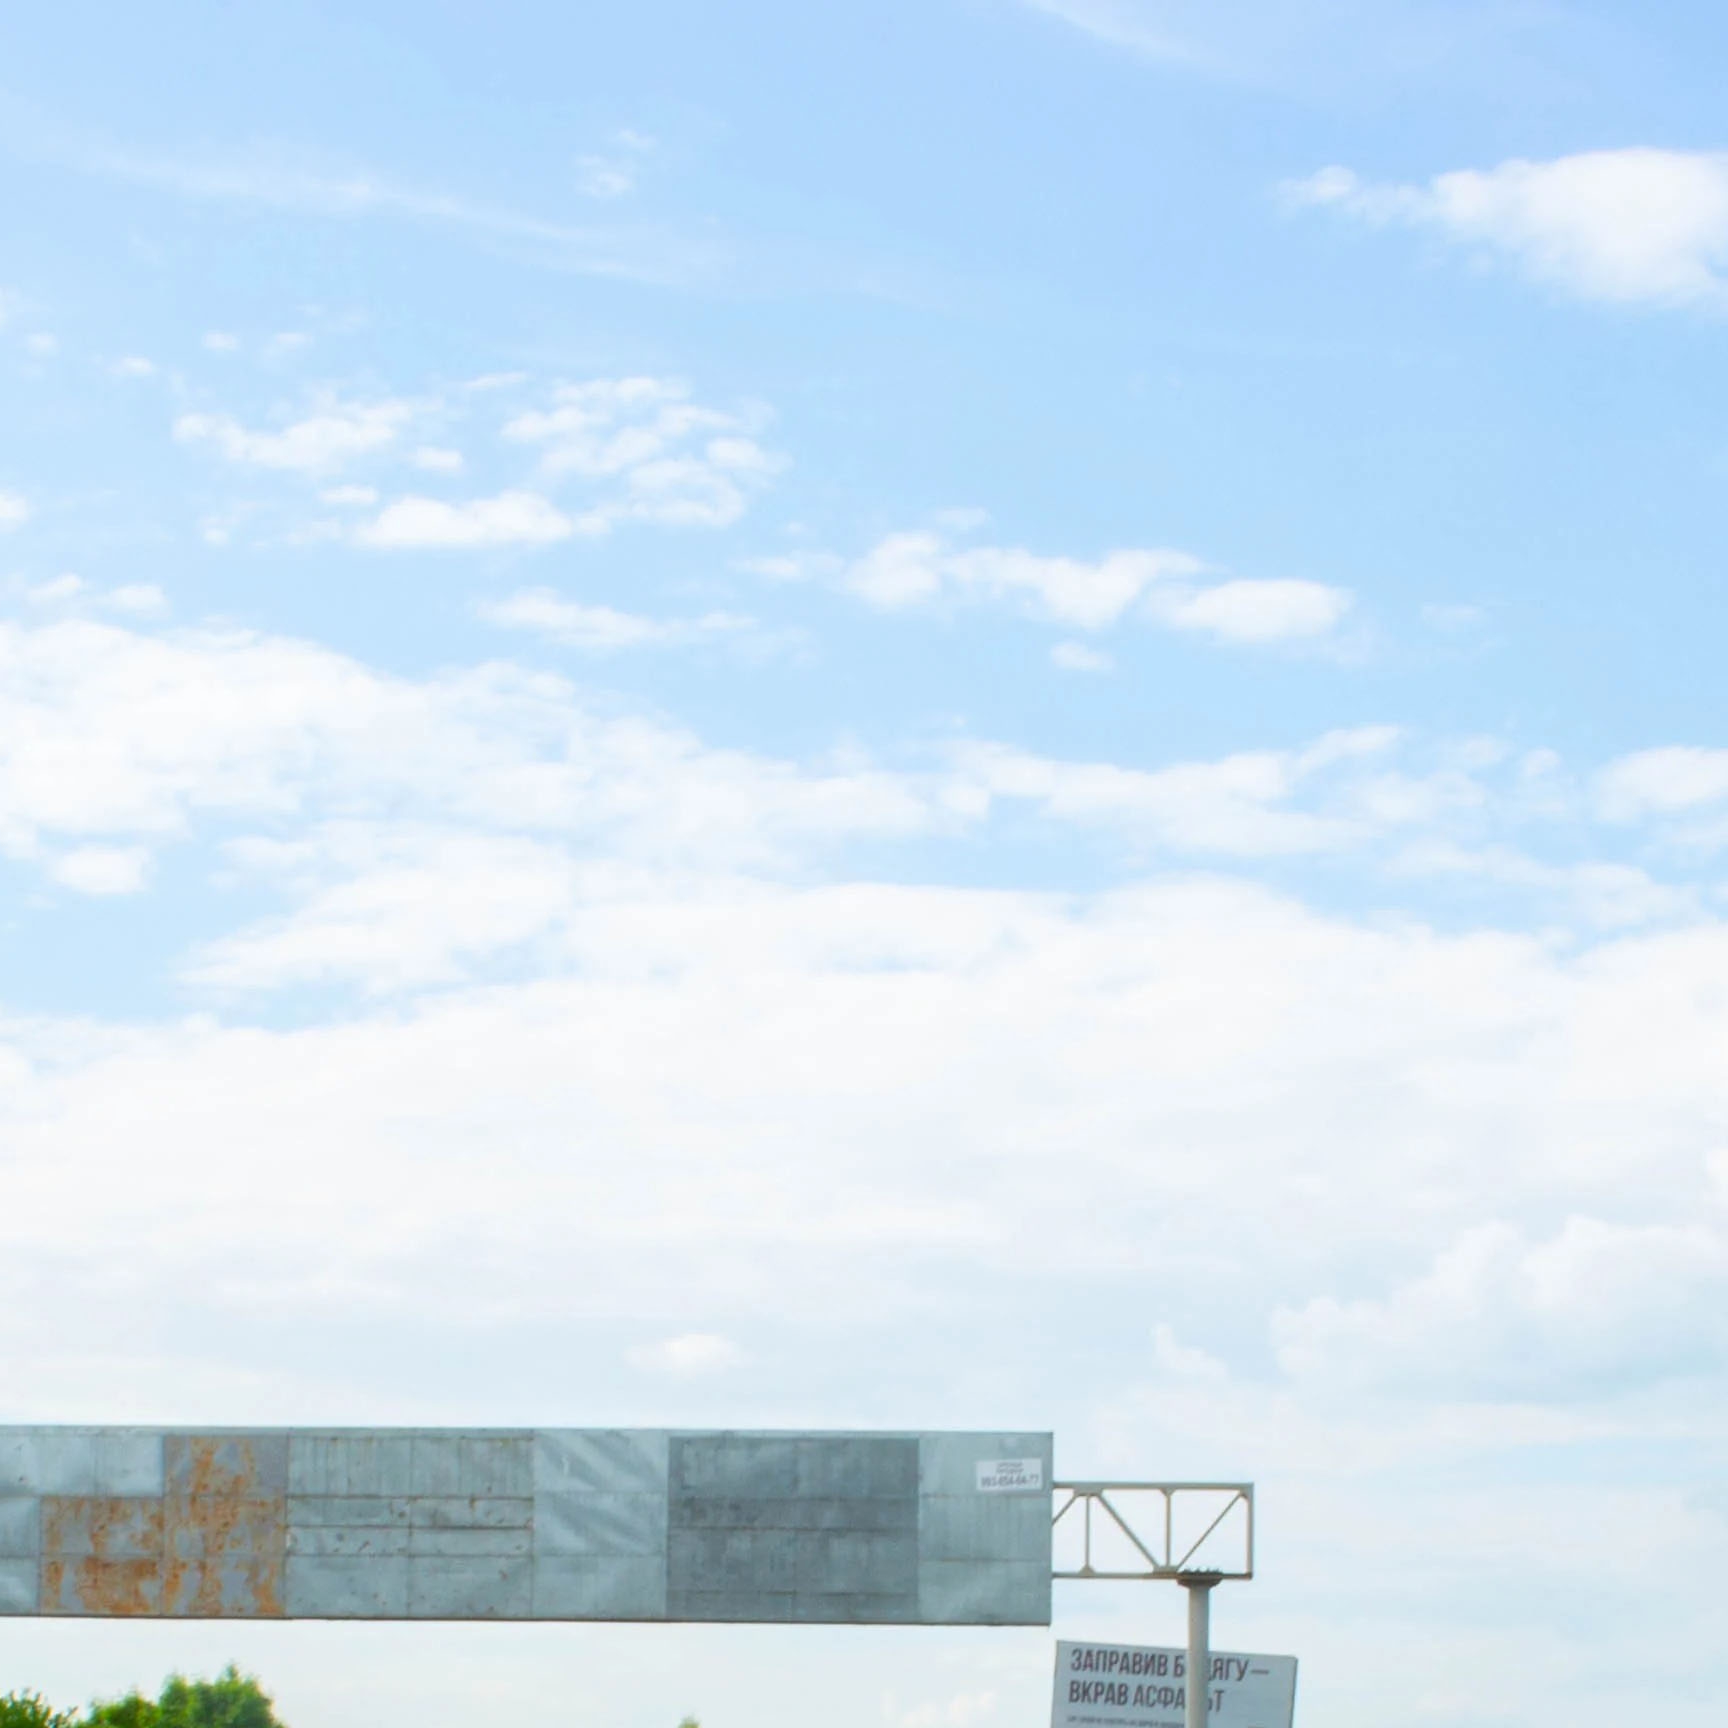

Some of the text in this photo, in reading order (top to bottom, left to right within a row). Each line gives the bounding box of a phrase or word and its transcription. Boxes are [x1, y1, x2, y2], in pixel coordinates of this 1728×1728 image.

[1071, 1648, 1168, 1676] ЗАПРАВИВ
[1173, 1655, 1249, 1681] БЯГУ
[1068, 1679, 1224, 1712] ВКРАВ АСФАТ
